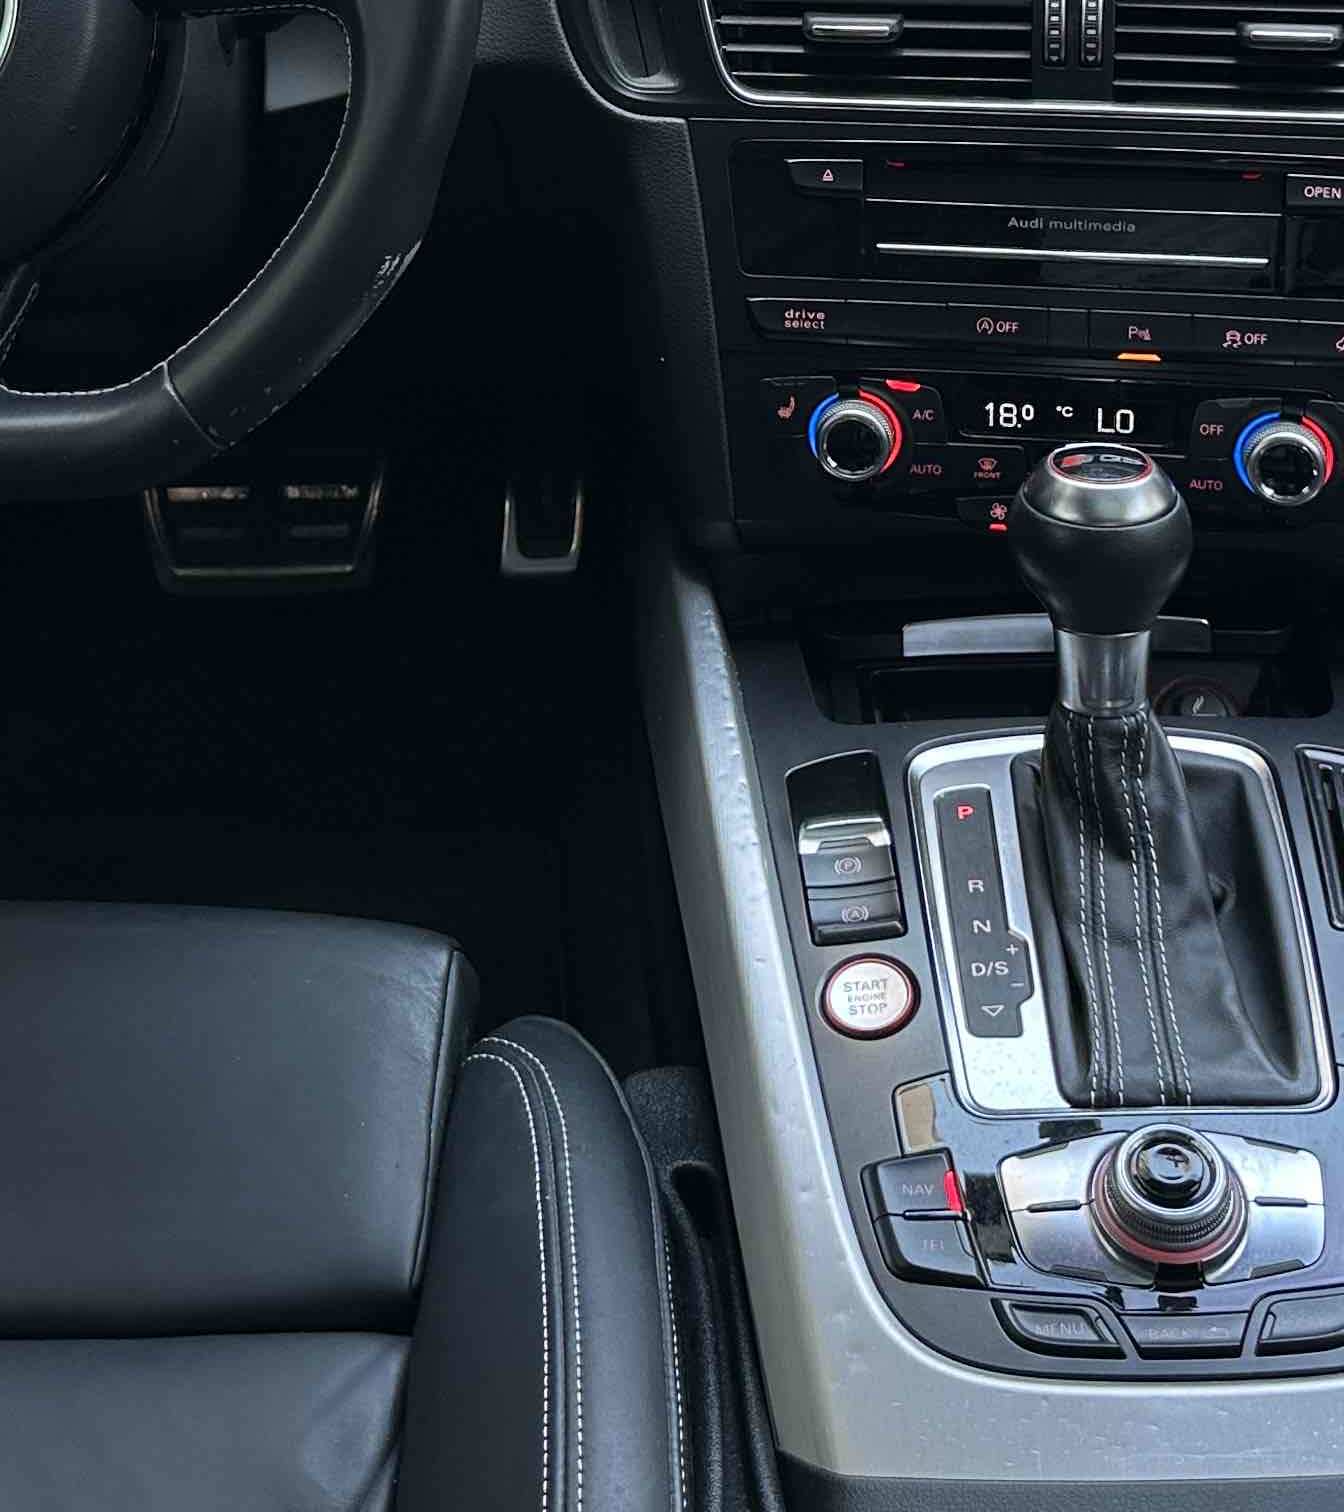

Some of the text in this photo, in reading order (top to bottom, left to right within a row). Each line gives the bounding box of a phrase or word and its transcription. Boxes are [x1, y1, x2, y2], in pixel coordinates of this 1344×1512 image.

[1304, 185, 1343, 200] OPEN
[1007, 216, 1136, 233] Audi multimedia
[784, 308, 826, 320] drive
[784, 319, 825, 330] select
[996, 321, 1020, 334] OFF
[1244, 332, 1268, 345] OFF
[912, 409, 935, 421] A/C
[1097, 407, 1135, 434] LO
[1199, 423, 1224, 436] OFF
[909, 463, 943, 476] AUTO
[972, 471, 1002, 480] FRONT
[1189, 479, 1224, 491] AUTO
[957, 805, 976, 820] P
[968, 879, 985, 893] R
[973, 919, 992, 934] N
[971, 960, 1009, 977] D/S
[843, 978, 889, 993] START
[847, 991, 887, 1003] ENGINE
[849, 1001, 888, 1016] STOP
[902, 1183, 936, 1197] NAV
